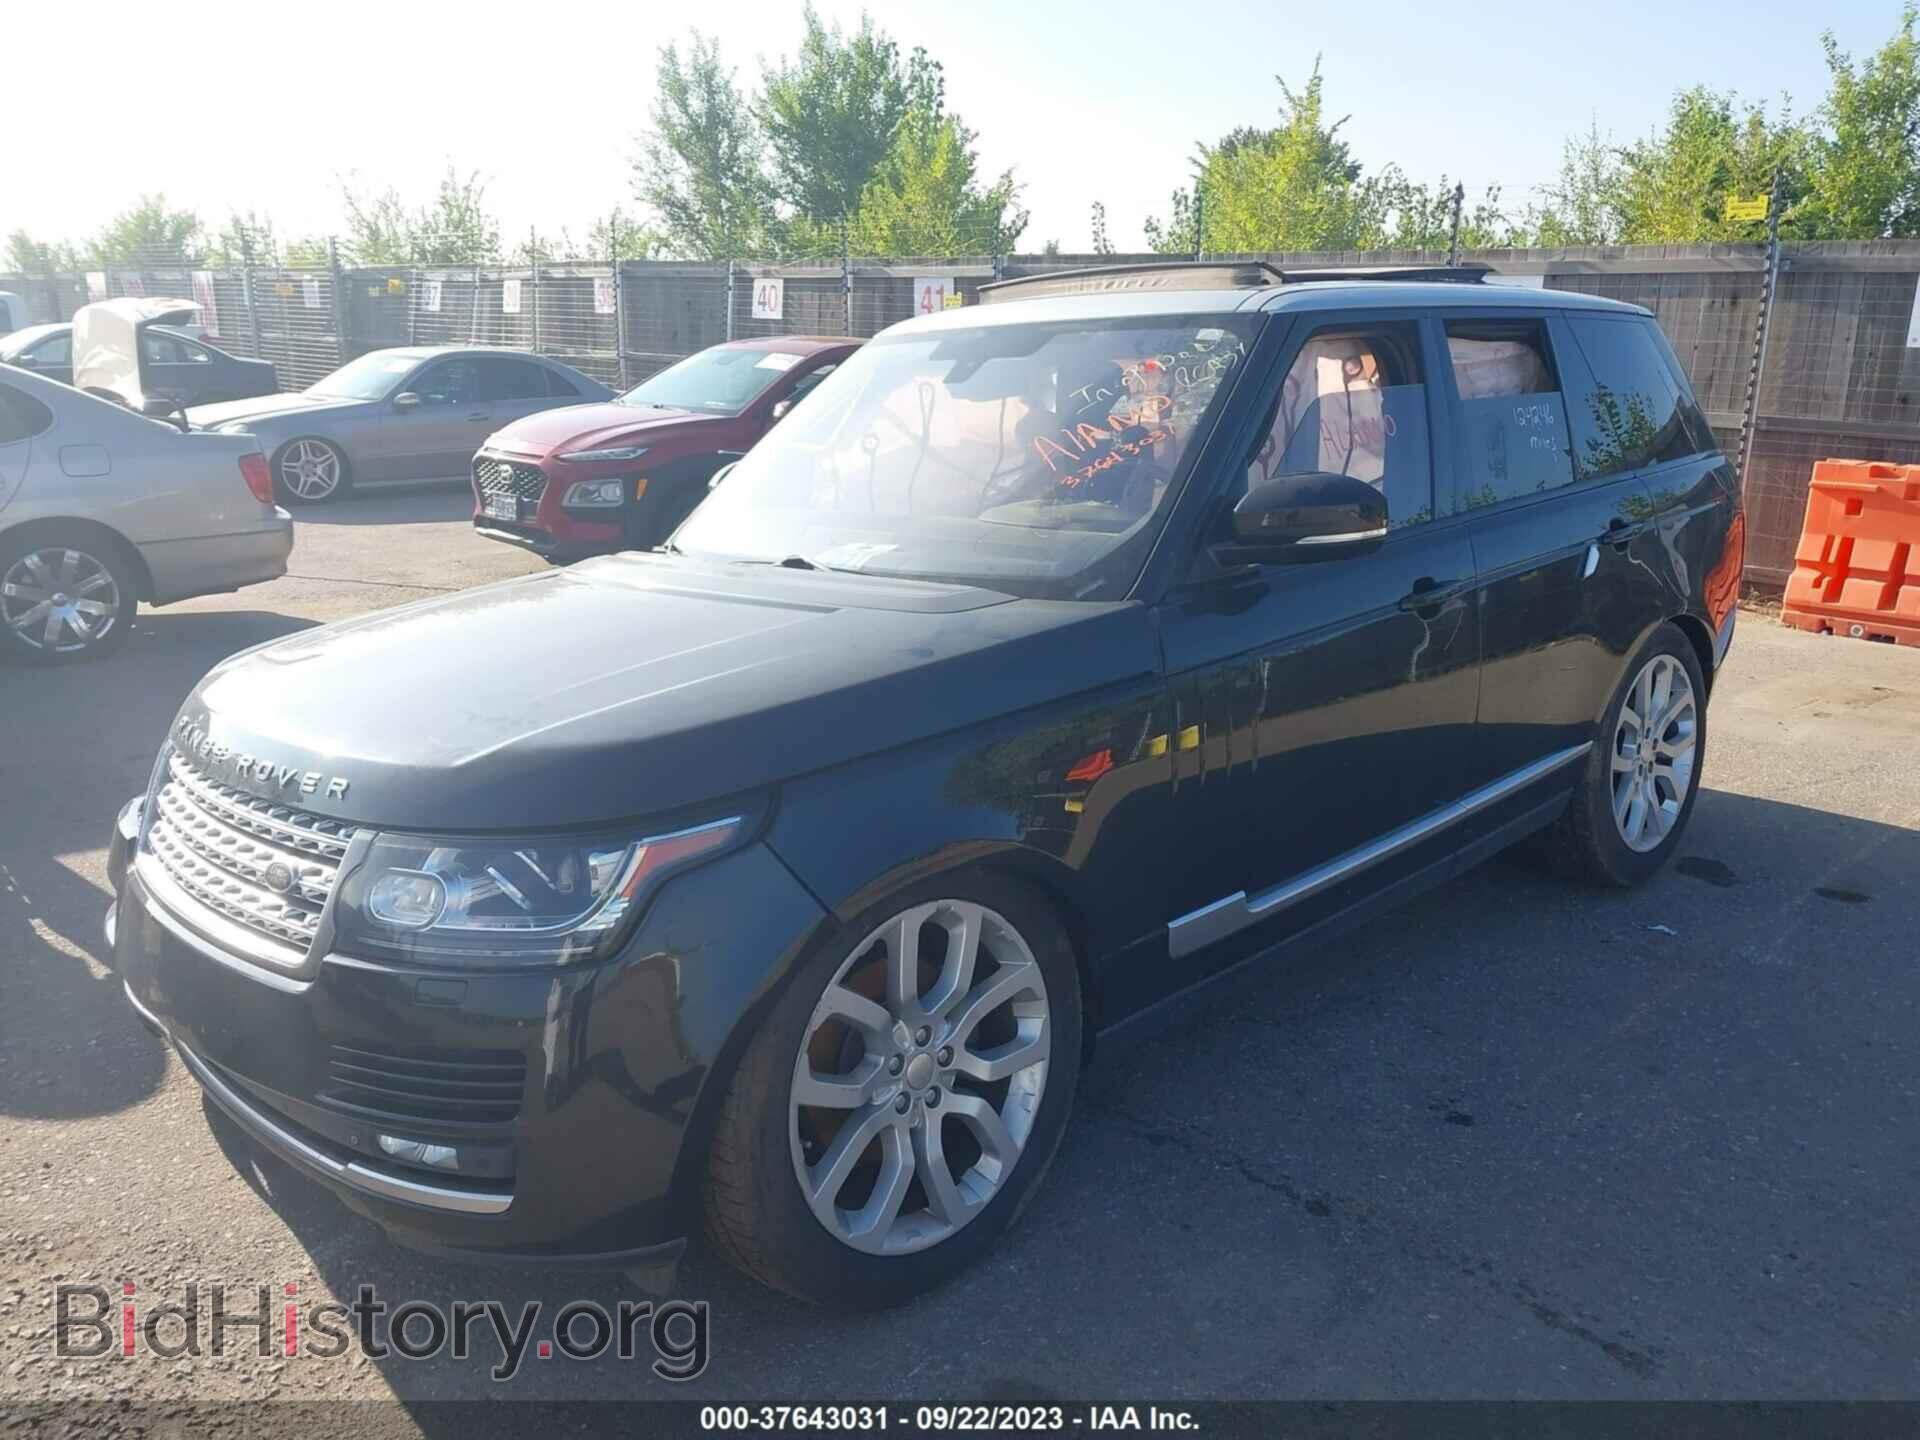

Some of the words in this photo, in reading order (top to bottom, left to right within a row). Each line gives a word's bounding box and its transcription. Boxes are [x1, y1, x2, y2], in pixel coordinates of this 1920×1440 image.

[757, 284, 778, 312] 40
[920, 284, 945, 314] 41
[236, 753, 348, 800] ROVER
